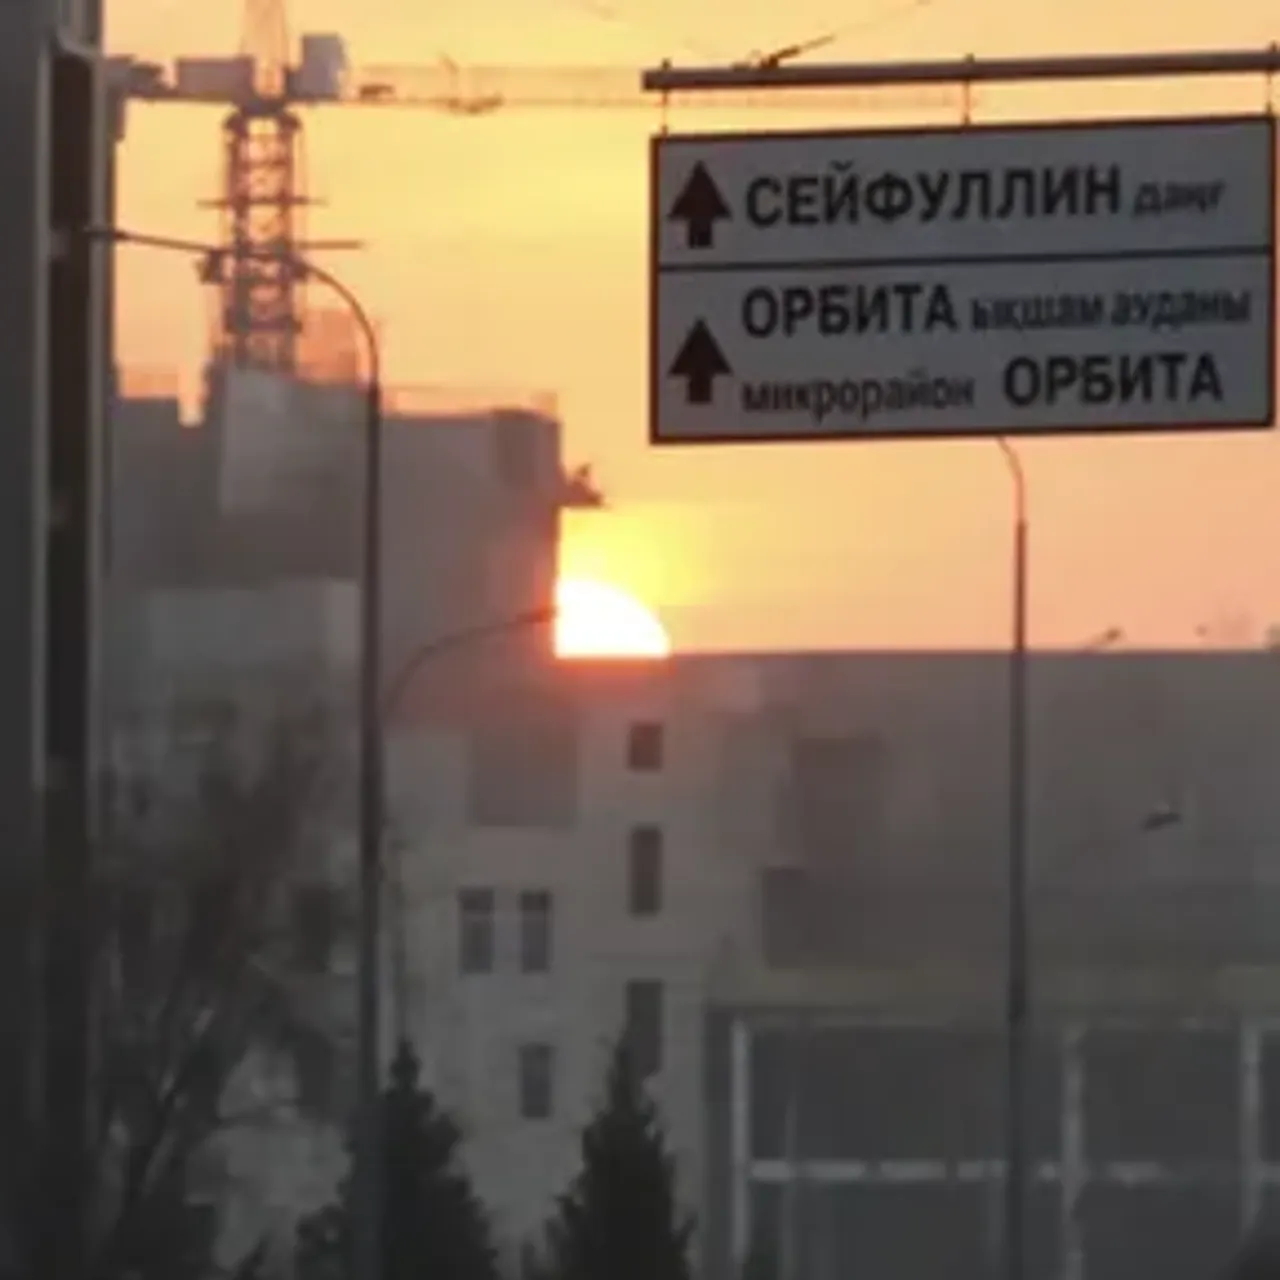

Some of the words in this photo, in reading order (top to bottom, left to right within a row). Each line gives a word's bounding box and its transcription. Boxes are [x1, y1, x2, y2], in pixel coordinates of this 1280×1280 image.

[744, 160, 1121, 228] СЕЙФУЛЛИН
[743, 283, 958, 339] ОРБИТА
[742, 368, 974, 423] микрорайон
[1002, 352, 1224, 408] ОРБИТА
